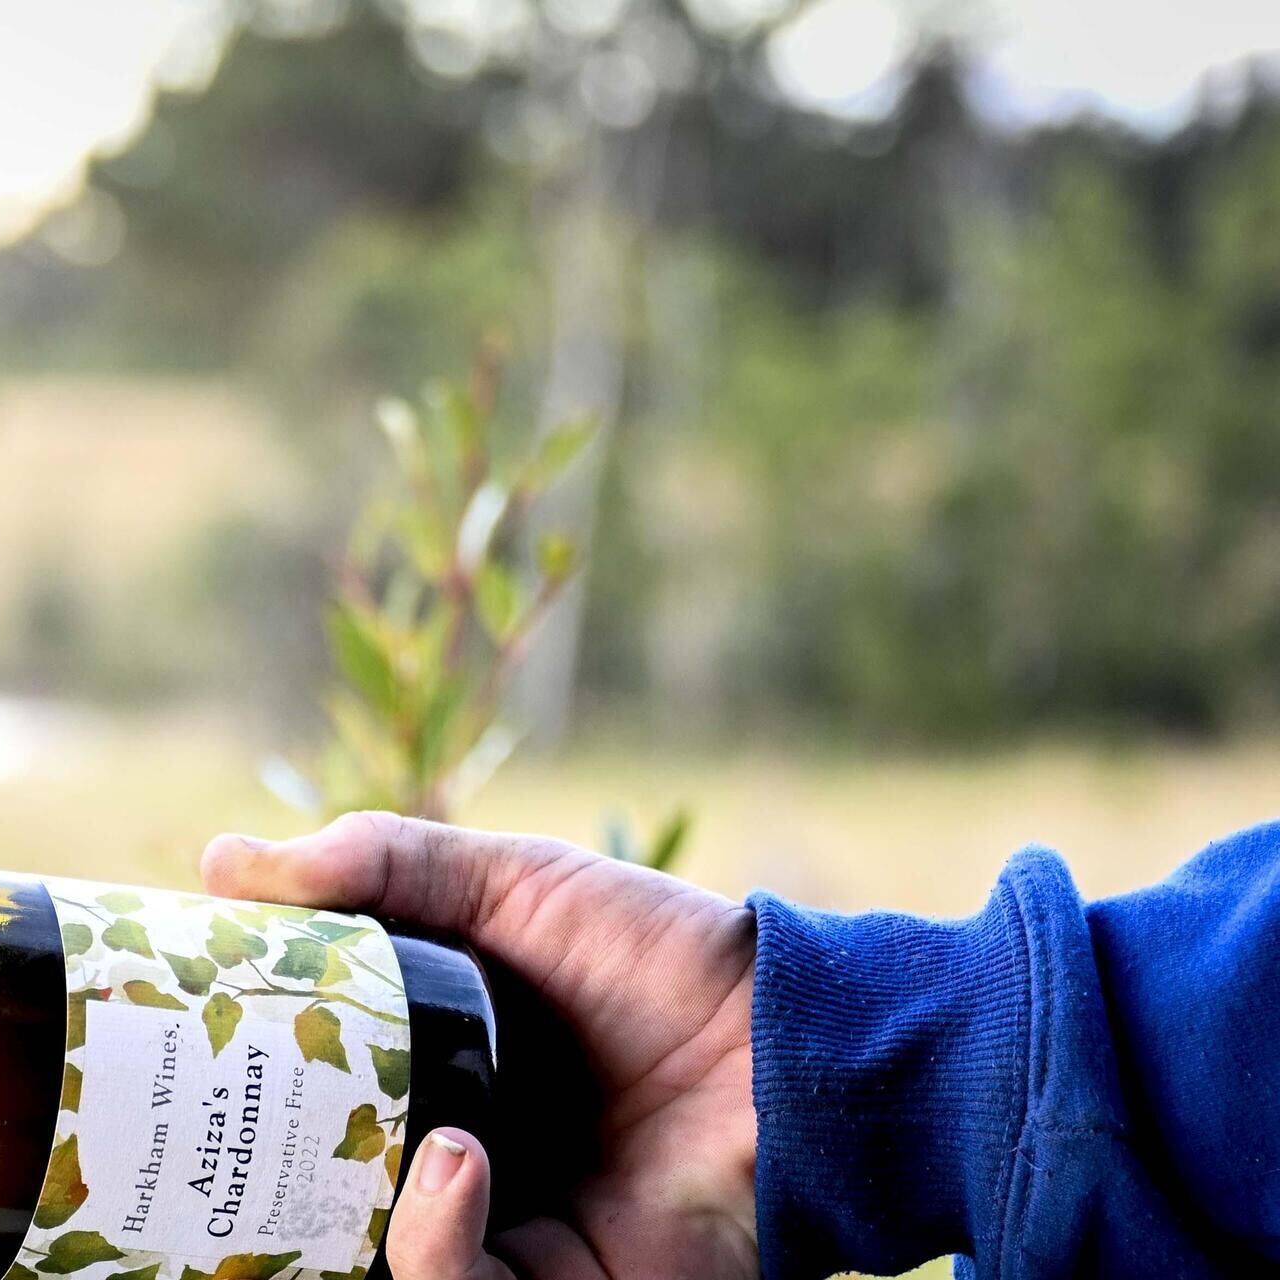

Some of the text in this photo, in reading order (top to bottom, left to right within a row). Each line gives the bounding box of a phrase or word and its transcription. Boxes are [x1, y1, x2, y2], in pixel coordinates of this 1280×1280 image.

[121, 1122, 170, 1233] Harkham
[186, 1087, 229, 1198] Aziza's
[206, 1044, 270, 1238] Chardonnay
[257, 1066, 305, 1236] Preservative Free
[297, 1135, 321, 1184] 2022
